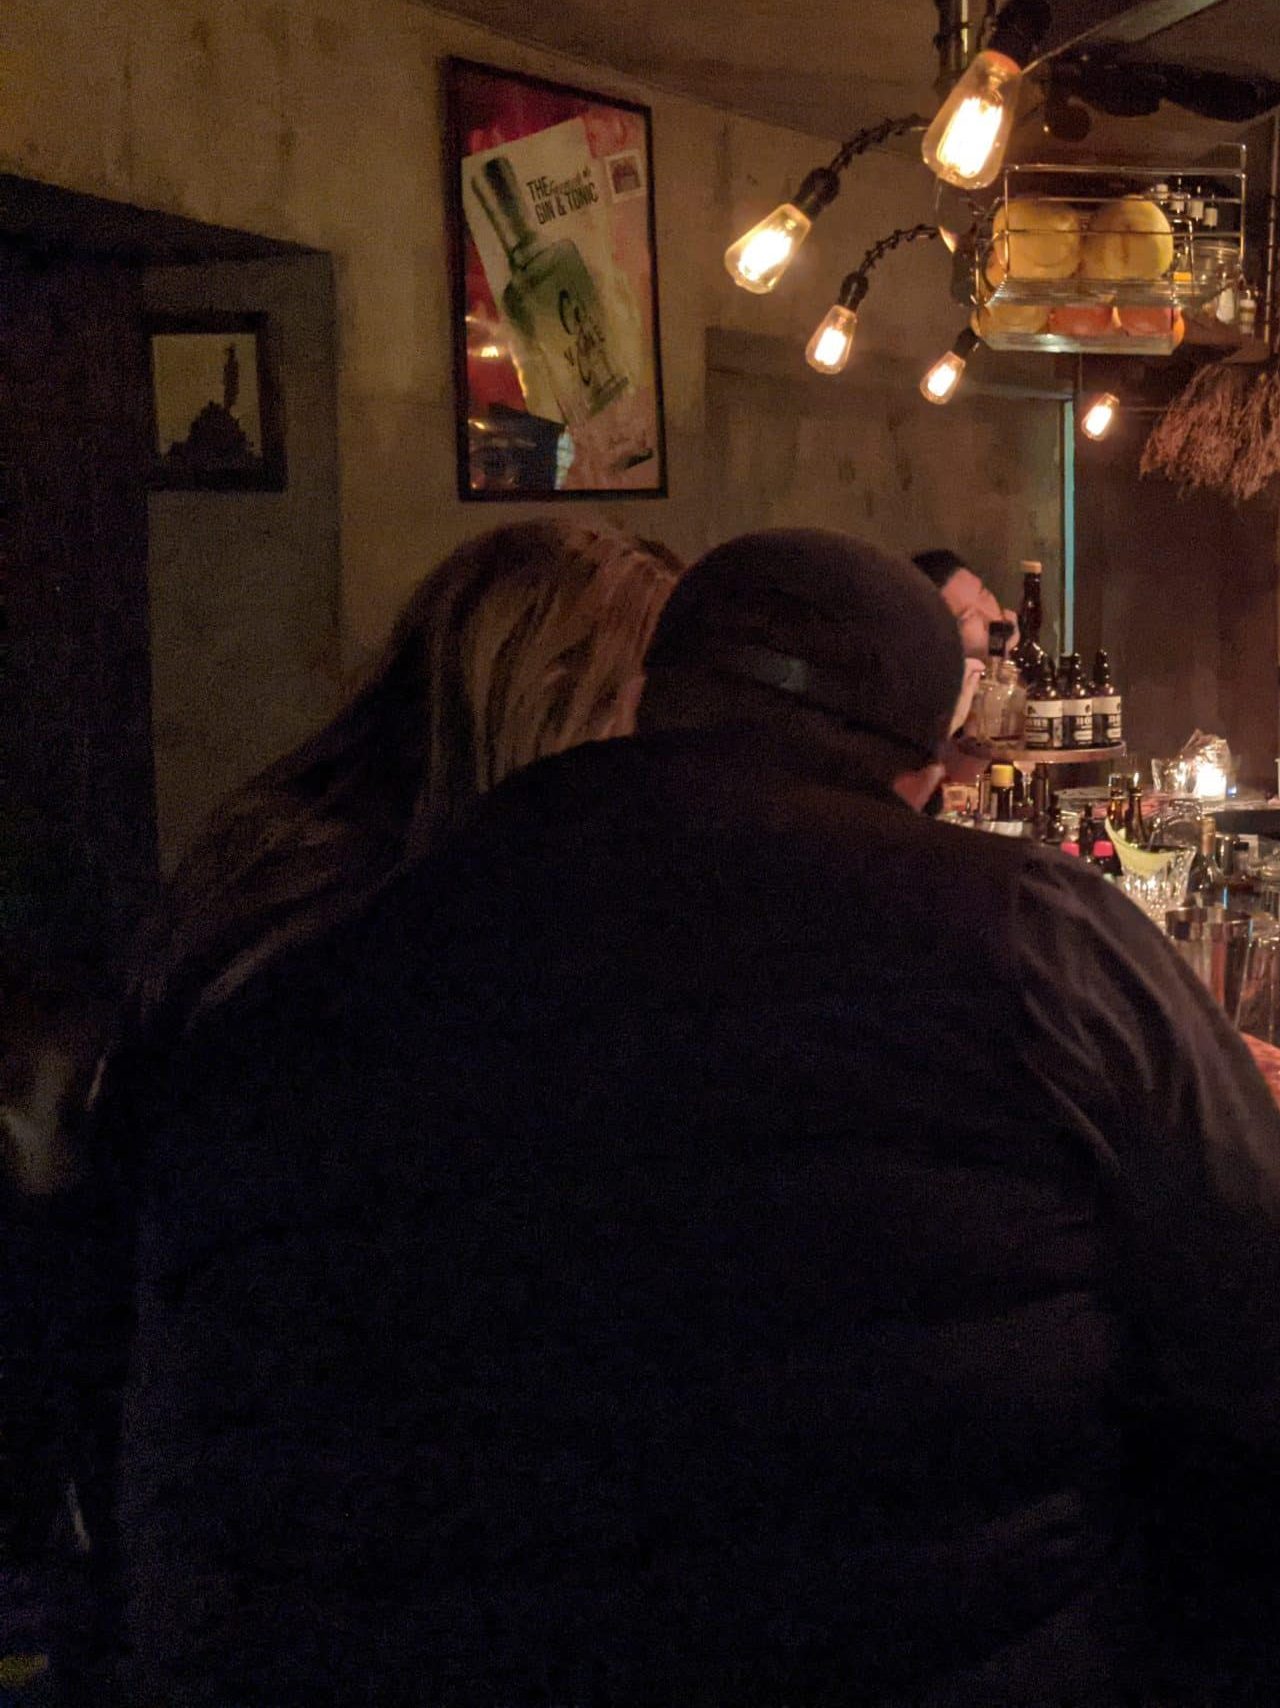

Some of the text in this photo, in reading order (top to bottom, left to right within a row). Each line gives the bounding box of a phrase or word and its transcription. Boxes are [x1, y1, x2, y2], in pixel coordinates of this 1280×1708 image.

[527, 177, 551, 201] THE
[535, 183, 599, 224] GIN & TONIC
